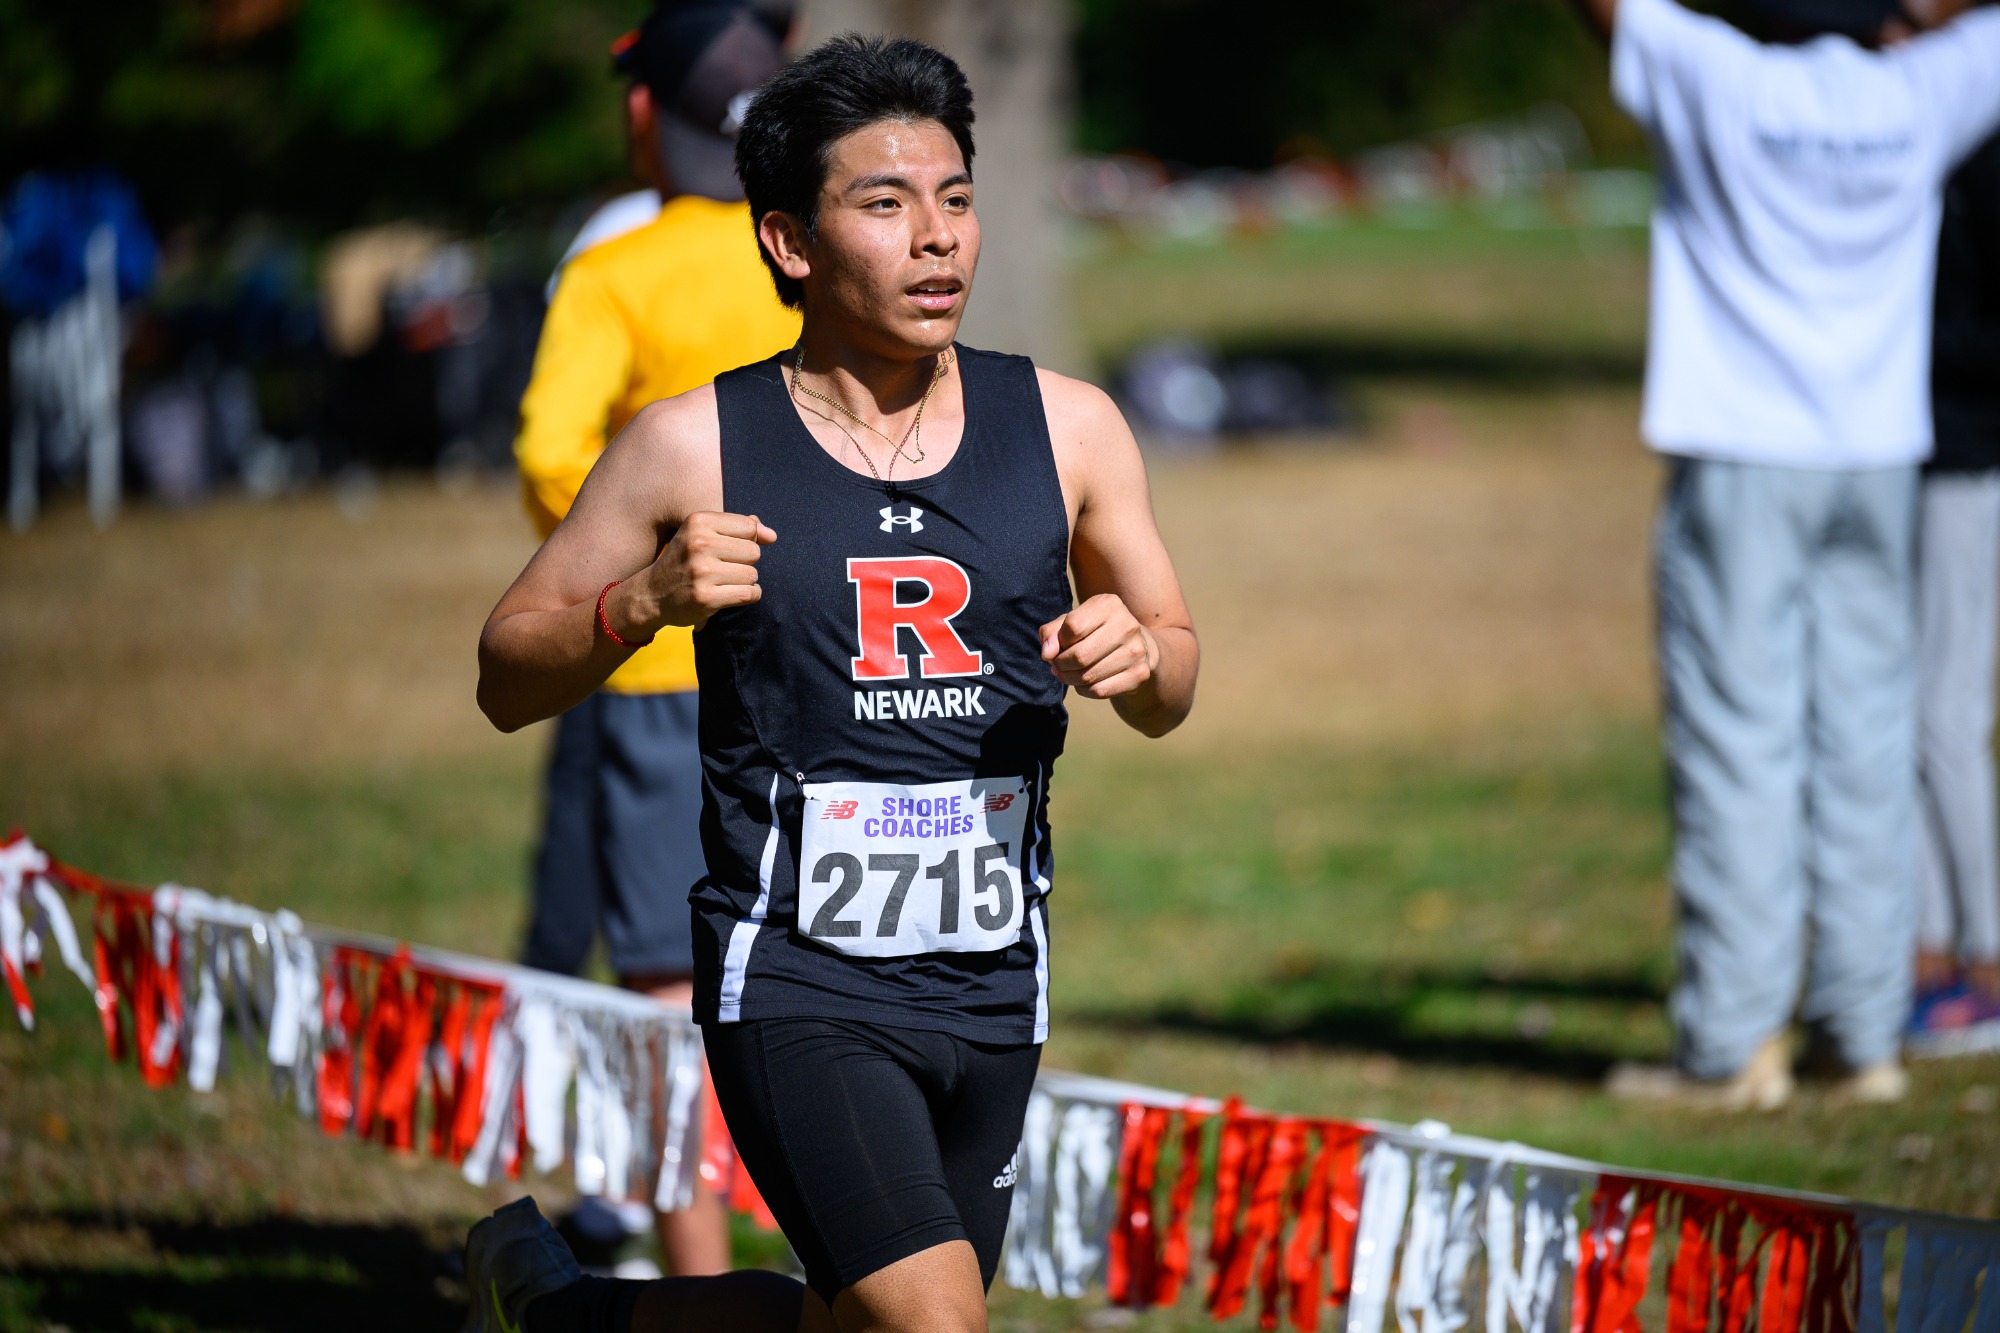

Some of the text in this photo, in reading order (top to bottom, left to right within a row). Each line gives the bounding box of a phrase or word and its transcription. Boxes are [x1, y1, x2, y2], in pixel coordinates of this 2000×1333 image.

[846, 556, 982, 681] R
[854, 686, 986, 720] NEWARK
[882, 795, 961, 817] SHORE
[864, 814, 974, 838] COACHES
[809, 841, 1014, 937] 2715
